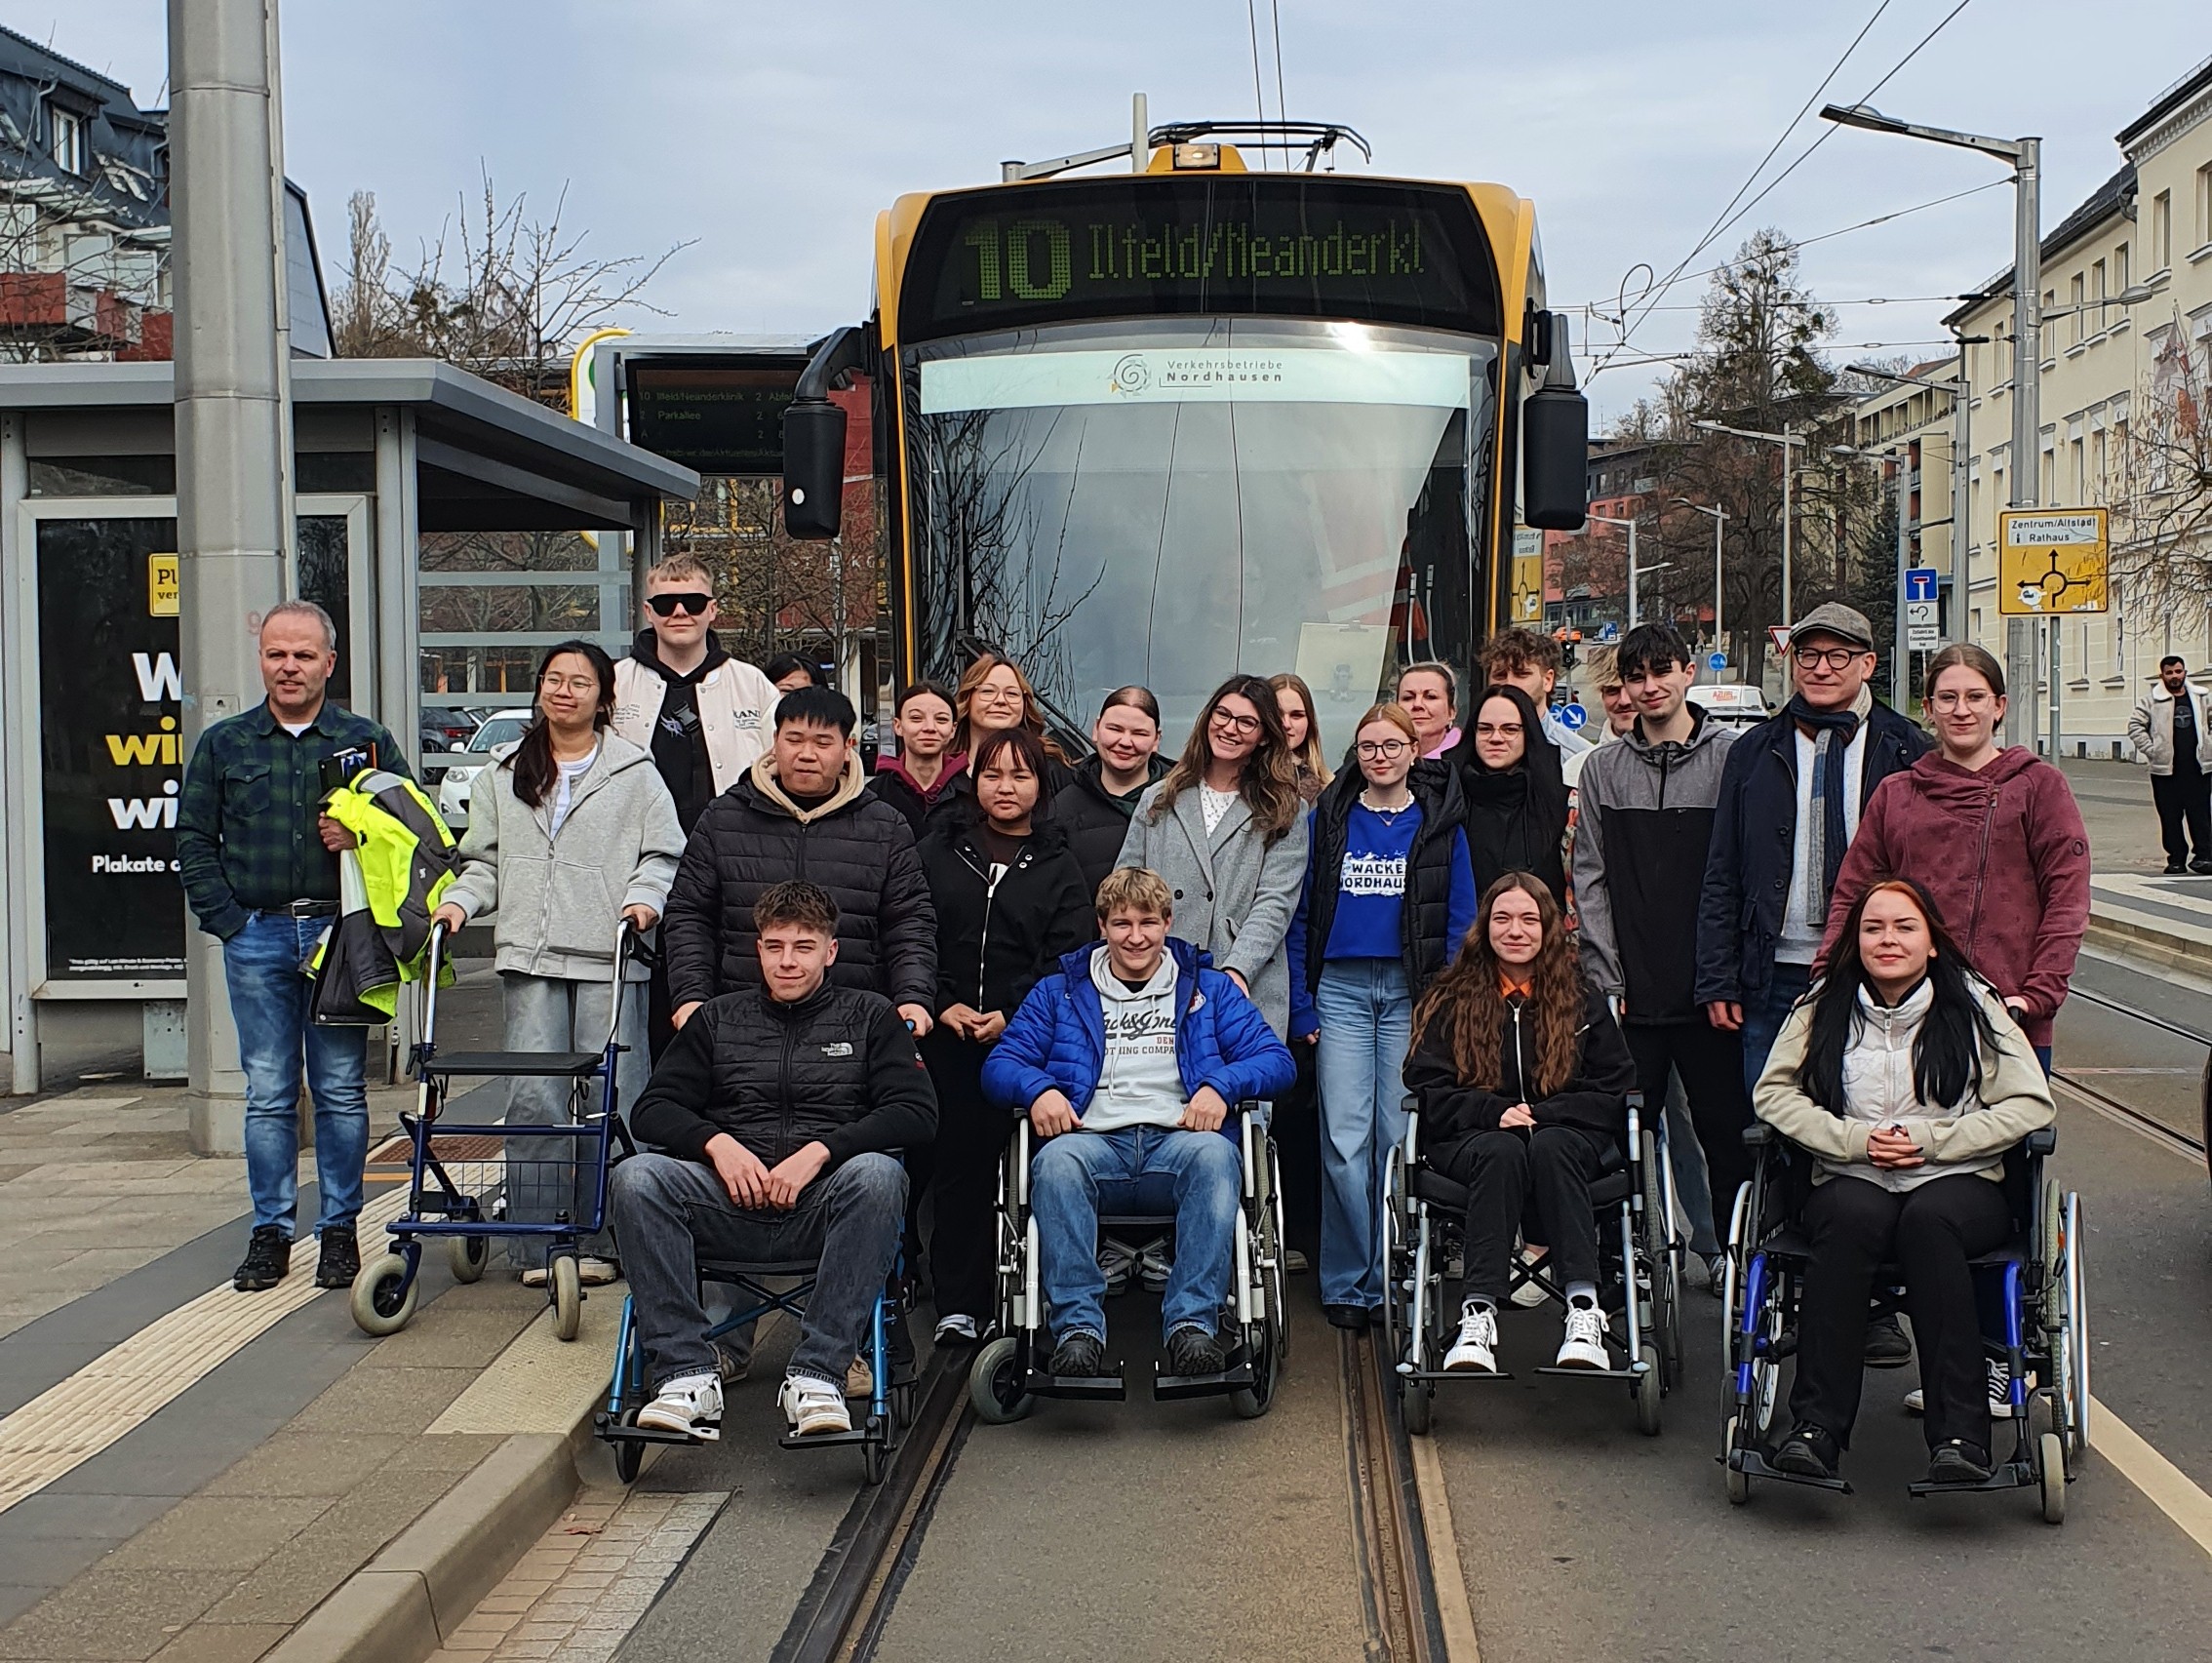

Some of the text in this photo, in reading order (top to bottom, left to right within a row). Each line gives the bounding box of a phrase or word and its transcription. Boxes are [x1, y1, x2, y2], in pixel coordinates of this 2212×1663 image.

[966, 220, 1072, 299] 10
[1167, 359, 1283, 370] Verkehrsbetriebe
[1166, 371, 1282, 381] Nordhausen
[2030, 534, 2070, 542] Rathaus
[92, 854, 166, 873] Plakate
